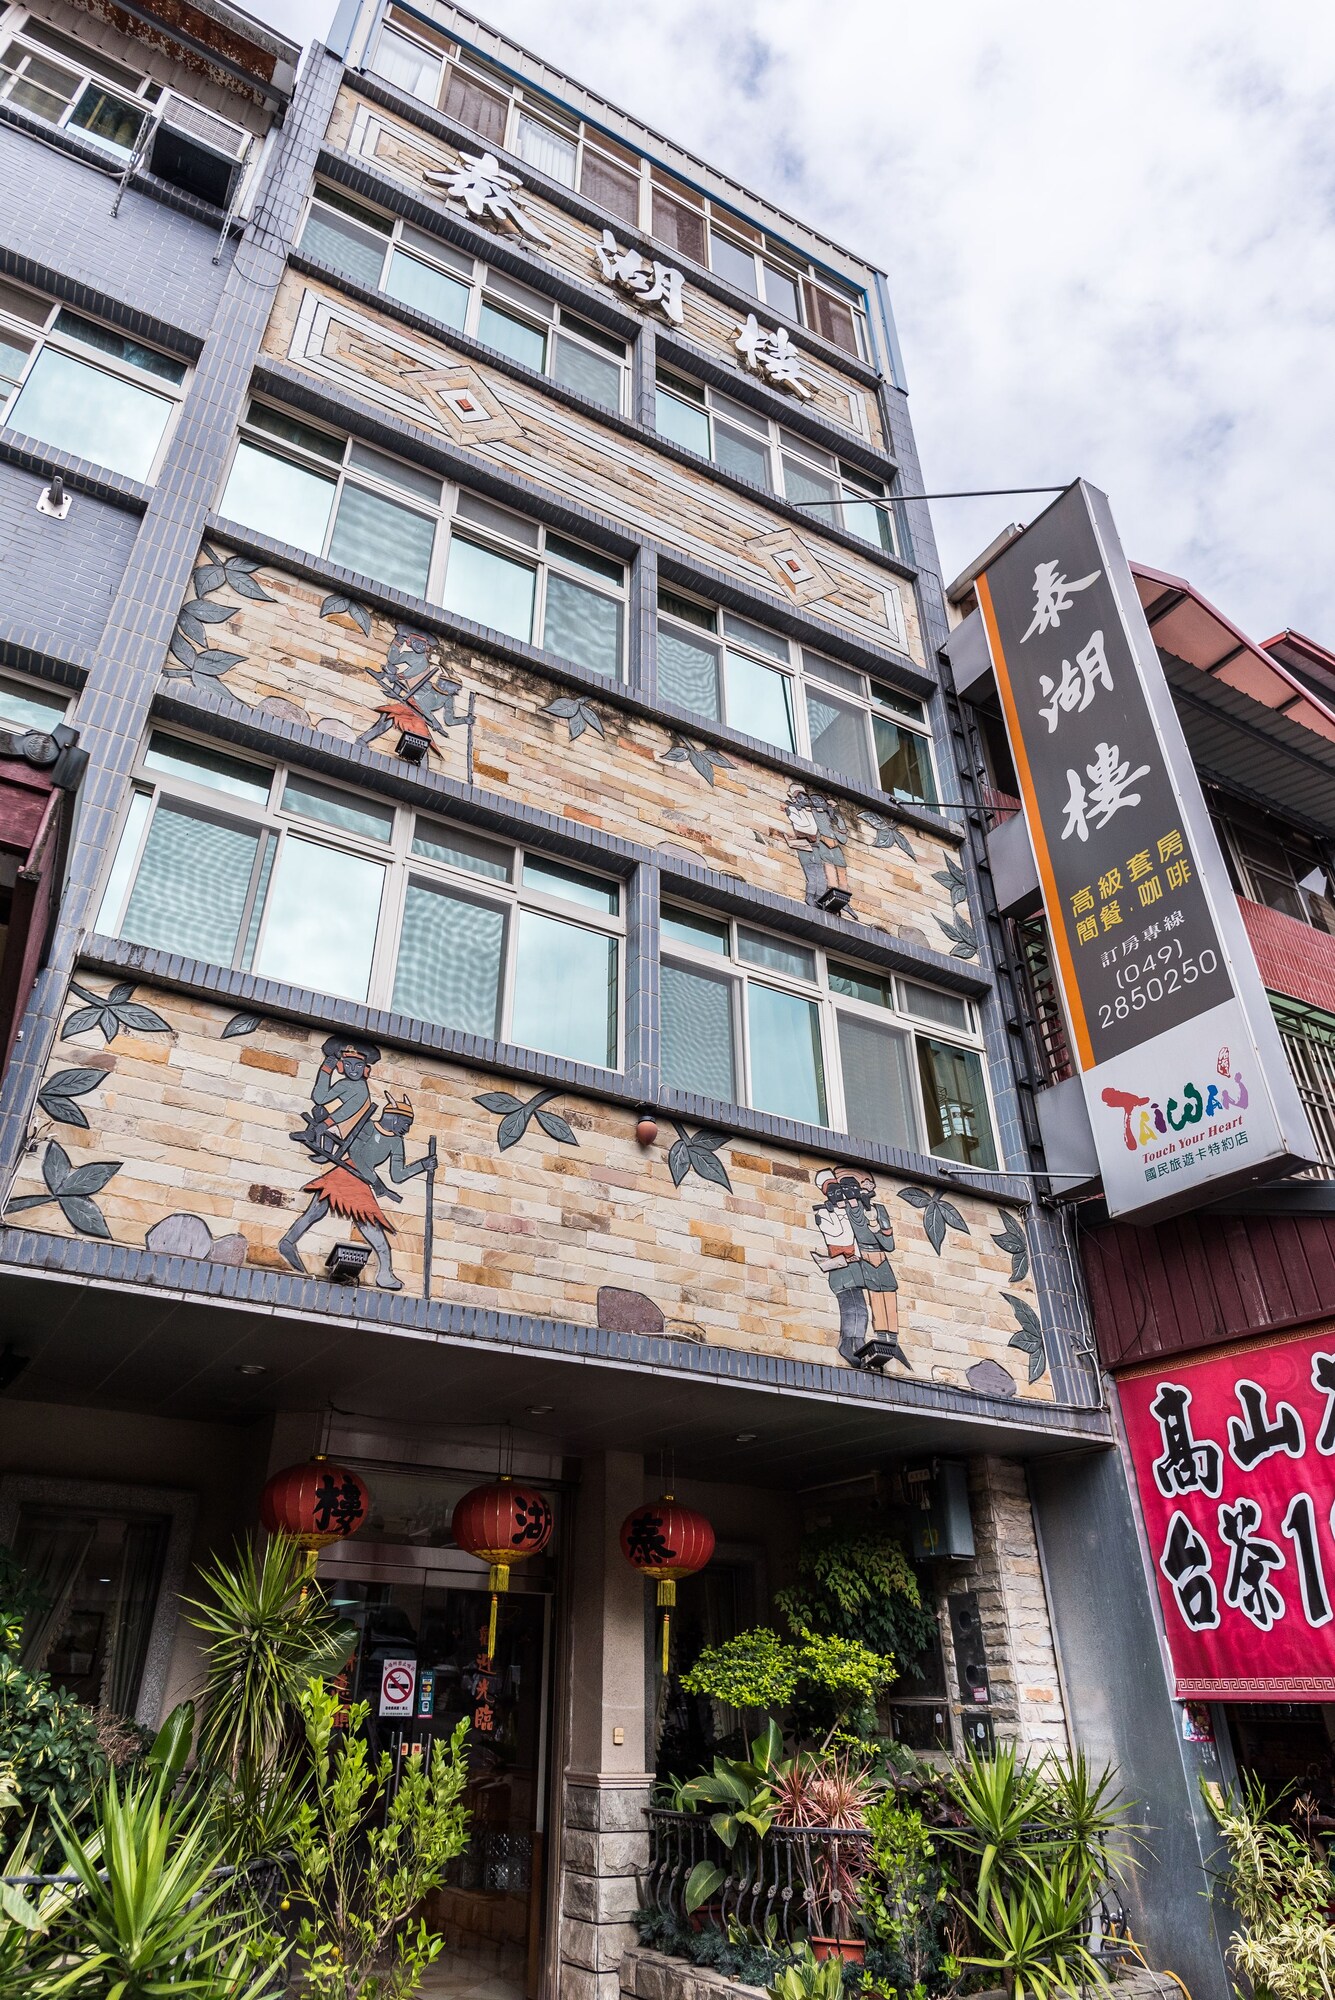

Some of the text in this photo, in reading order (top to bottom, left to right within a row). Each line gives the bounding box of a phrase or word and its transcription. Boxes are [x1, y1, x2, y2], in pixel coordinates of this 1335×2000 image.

[423, 152, 821, 398] 泰湖樓
[1019, 559, 1151, 843] 泰湖樓
[1070, 829, 1184, 918] 高級套房
[1100, 910, 1185, 968] 訂房專線
[1116, 938, 1183, 989] (049)
[1098, 949, 1218, 1029] 2850250
[1142, 1115, 1243, 1165] Touch Your Heart
[1144, 1131, 1249, 1182] 國民旅遊卡特約店
[312, 1475, 363, 1534] 樓
[627, 1513, 676, 1564] 泰
[1160, 1492, 1335, 1632] 台茶1
